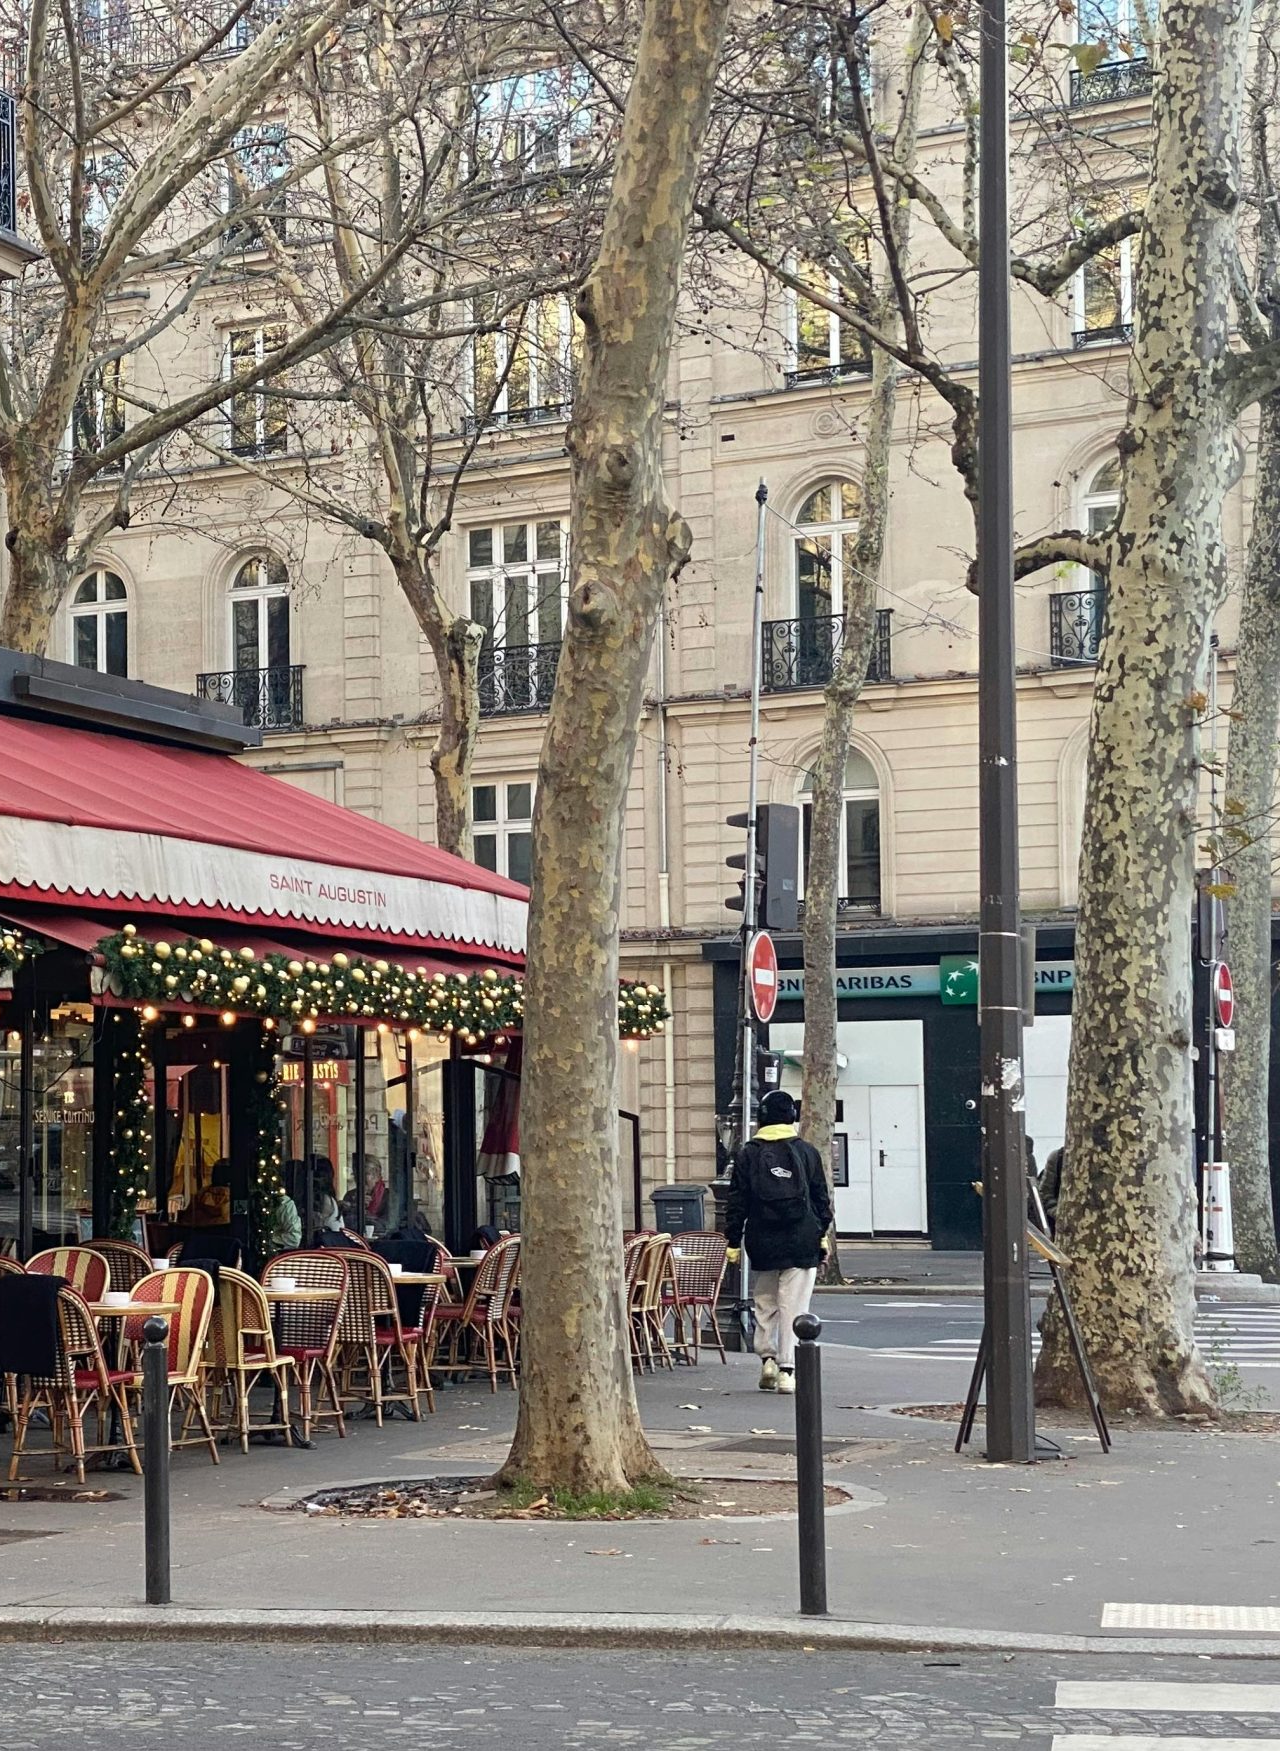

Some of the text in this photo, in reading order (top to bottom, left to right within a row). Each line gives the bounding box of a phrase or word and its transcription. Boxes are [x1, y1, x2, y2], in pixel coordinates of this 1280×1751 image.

[269, 873, 387, 908] SAINT AUGUSTIN
[777, 974, 913, 992] BN ARIBAS
[34, 1109, 95, 1124] SERVICE CONTINU
